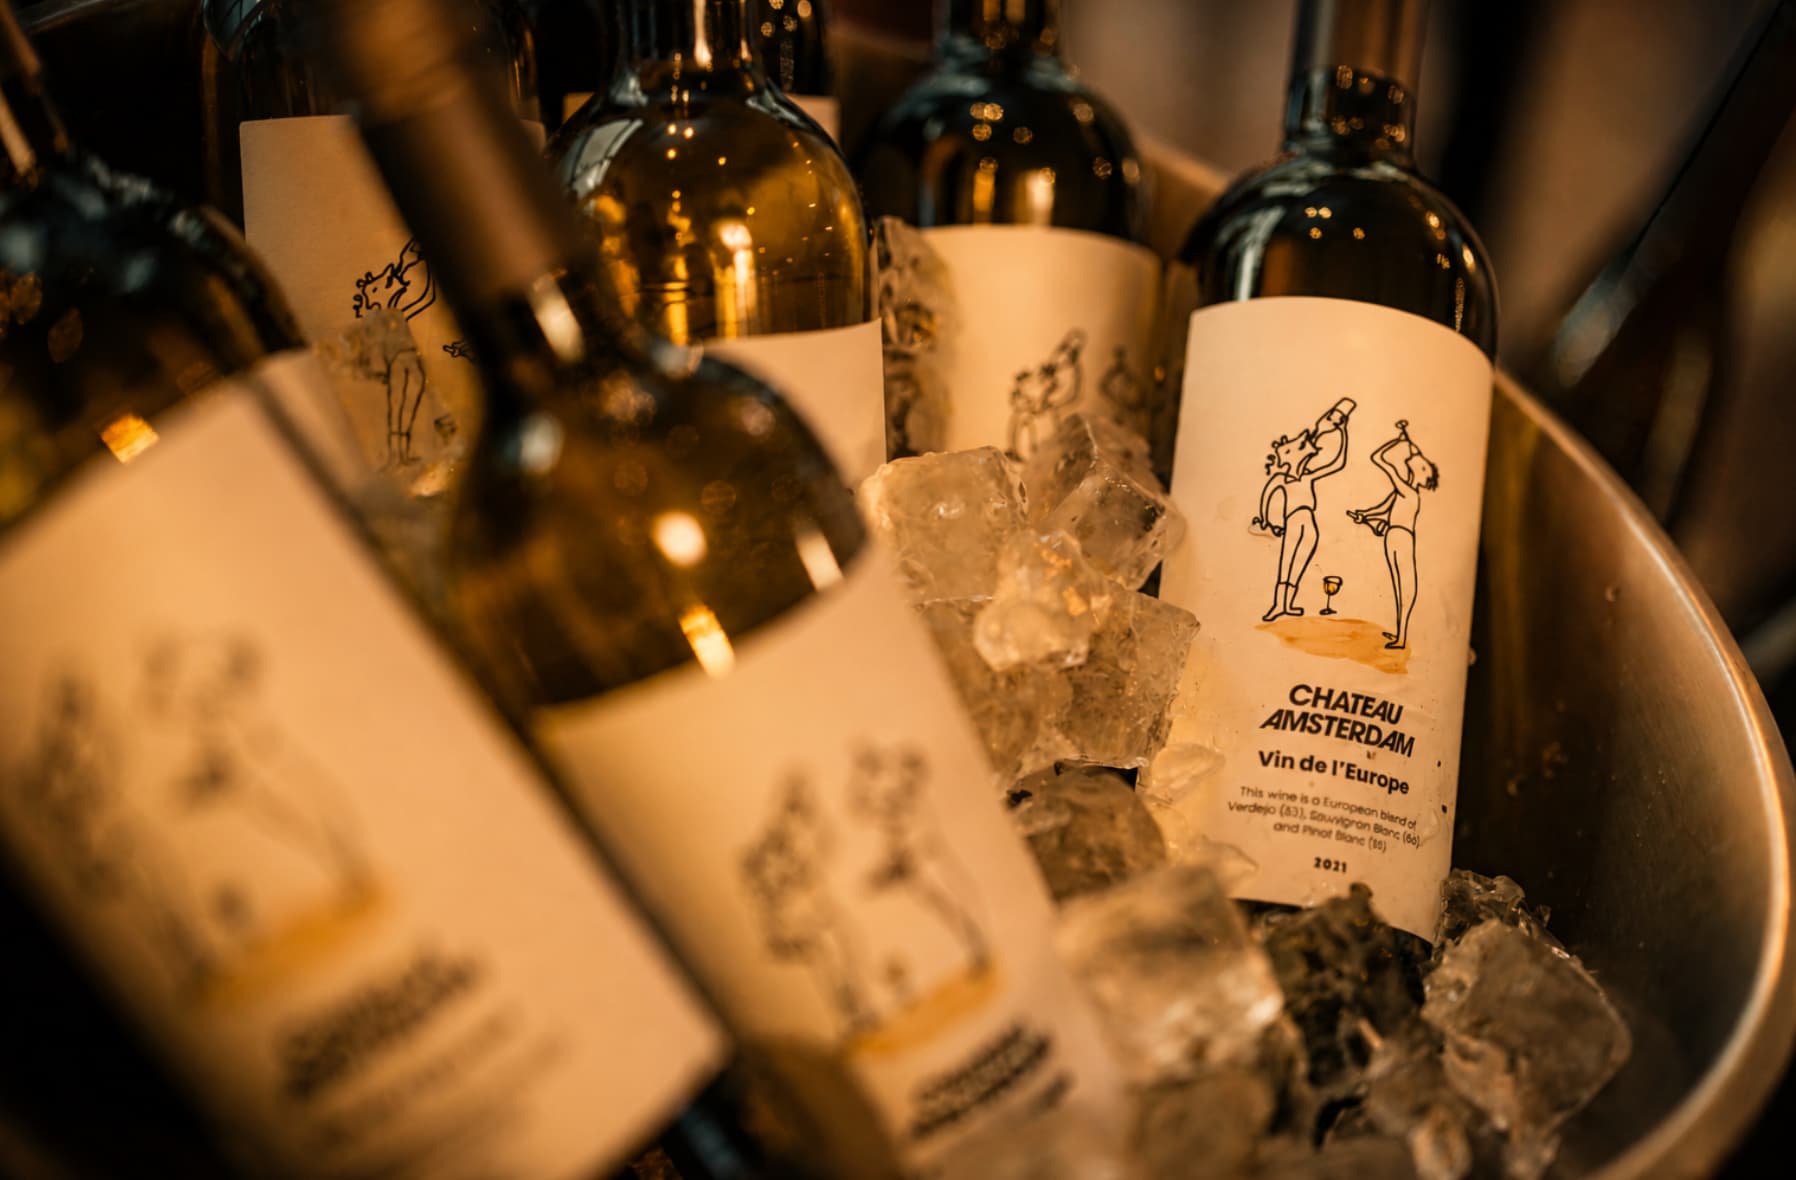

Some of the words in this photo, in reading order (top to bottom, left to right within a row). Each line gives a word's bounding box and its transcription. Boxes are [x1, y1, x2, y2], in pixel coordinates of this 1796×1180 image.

[1289, 684, 1403, 725] CHATEAU
[1259, 708, 1415, 758] AMSTERDAM
[1258, 749, 1295, 769] Vin
[1300, 755, 1327, 774] de
[1332, 760, 1410, 795] l'Europe
[1227, 800, 1276, 817] Verdejo
[1373, 822, 1401, 841] Blanc
[1240, 785, 1264, 799] This
[1267, 789, 1298, 802] wine
[1300, 793, 1309, 804] is
[1311, 796, 1320, 806] a
[1323, 796, 1378, 818] European
[1380, 809, 1407, 827] blend
[1407, 820, 1417, 832] of
[1273, 821, 1300, 834] and
[1302, 824, 1333, 840] Pinot
[1335, 829, 1366, 847] Blanc
[1314, 856, 1347, 874] 2021
